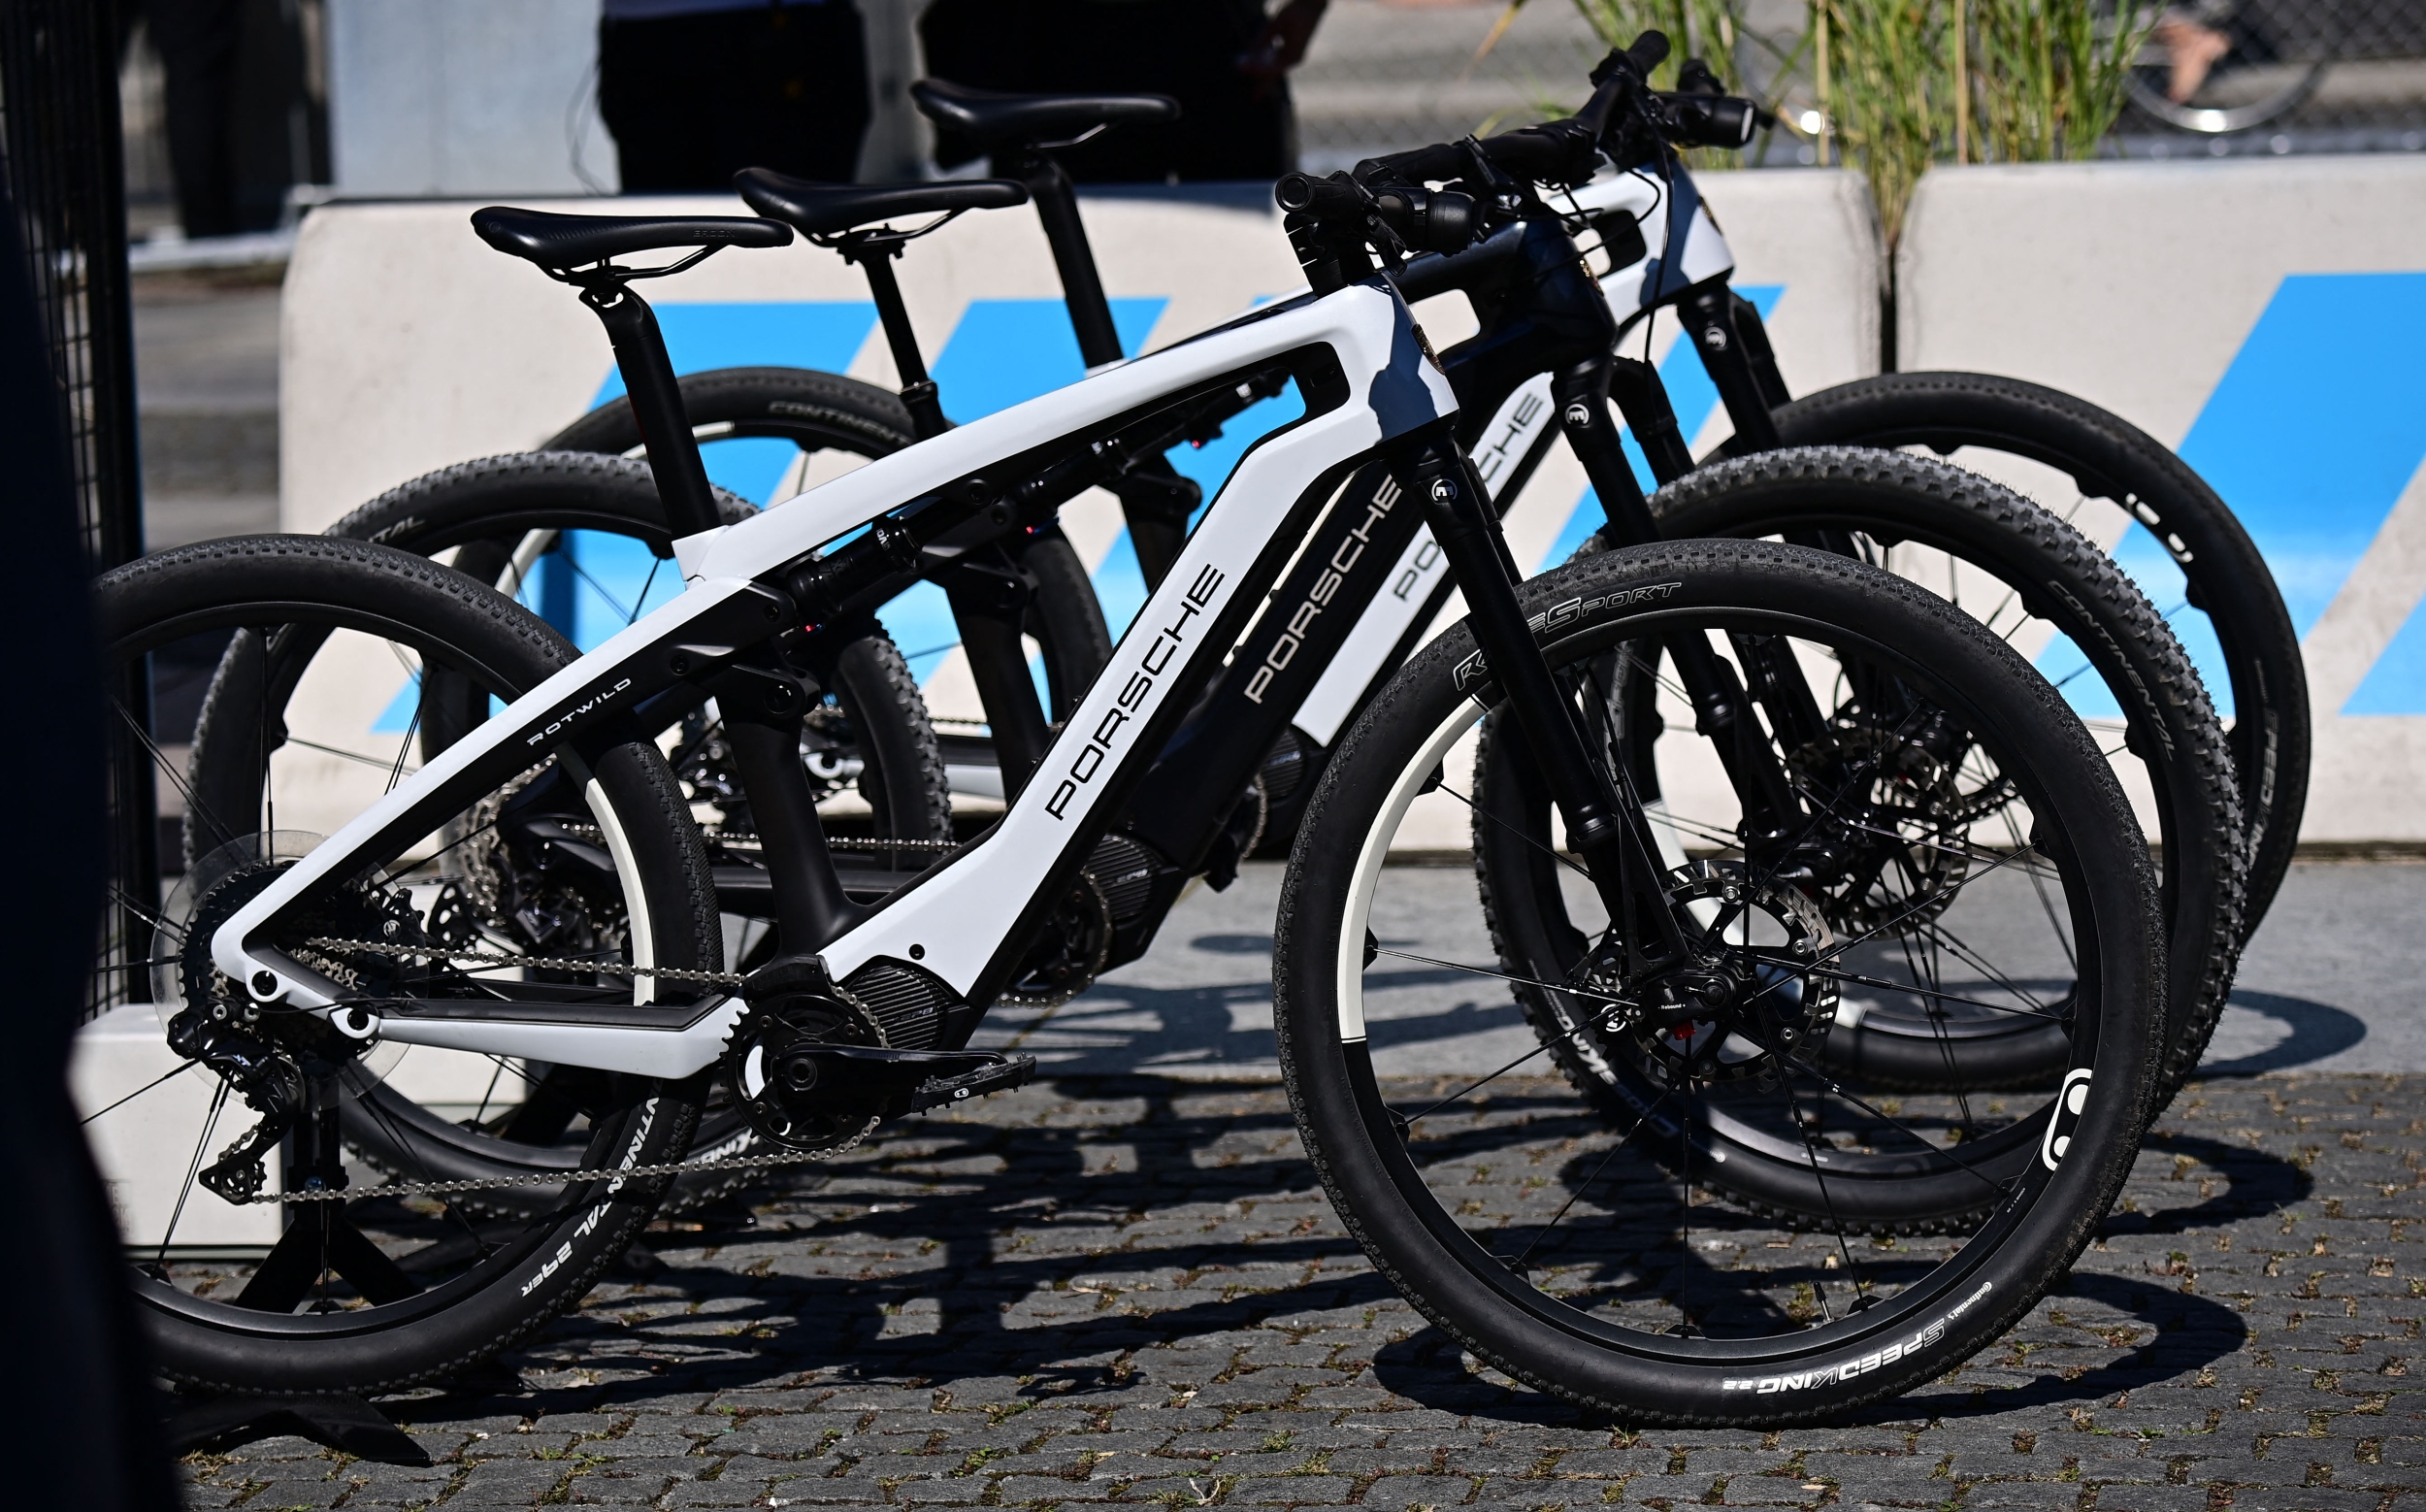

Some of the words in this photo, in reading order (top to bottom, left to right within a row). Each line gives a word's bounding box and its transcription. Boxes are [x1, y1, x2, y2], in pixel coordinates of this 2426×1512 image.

[1243, 473, 1403, 705] PORSCHE
[526, 677, 632, 746] ROTWILD
[1044, 563, 1226, 822] PORSCHE
[2049, 580, 2176, 762] CONTINENTAL
[1722, 1376, 1754, 1391] 2.2
[1755, 1317, 1946, 1395] SPEEDKING
